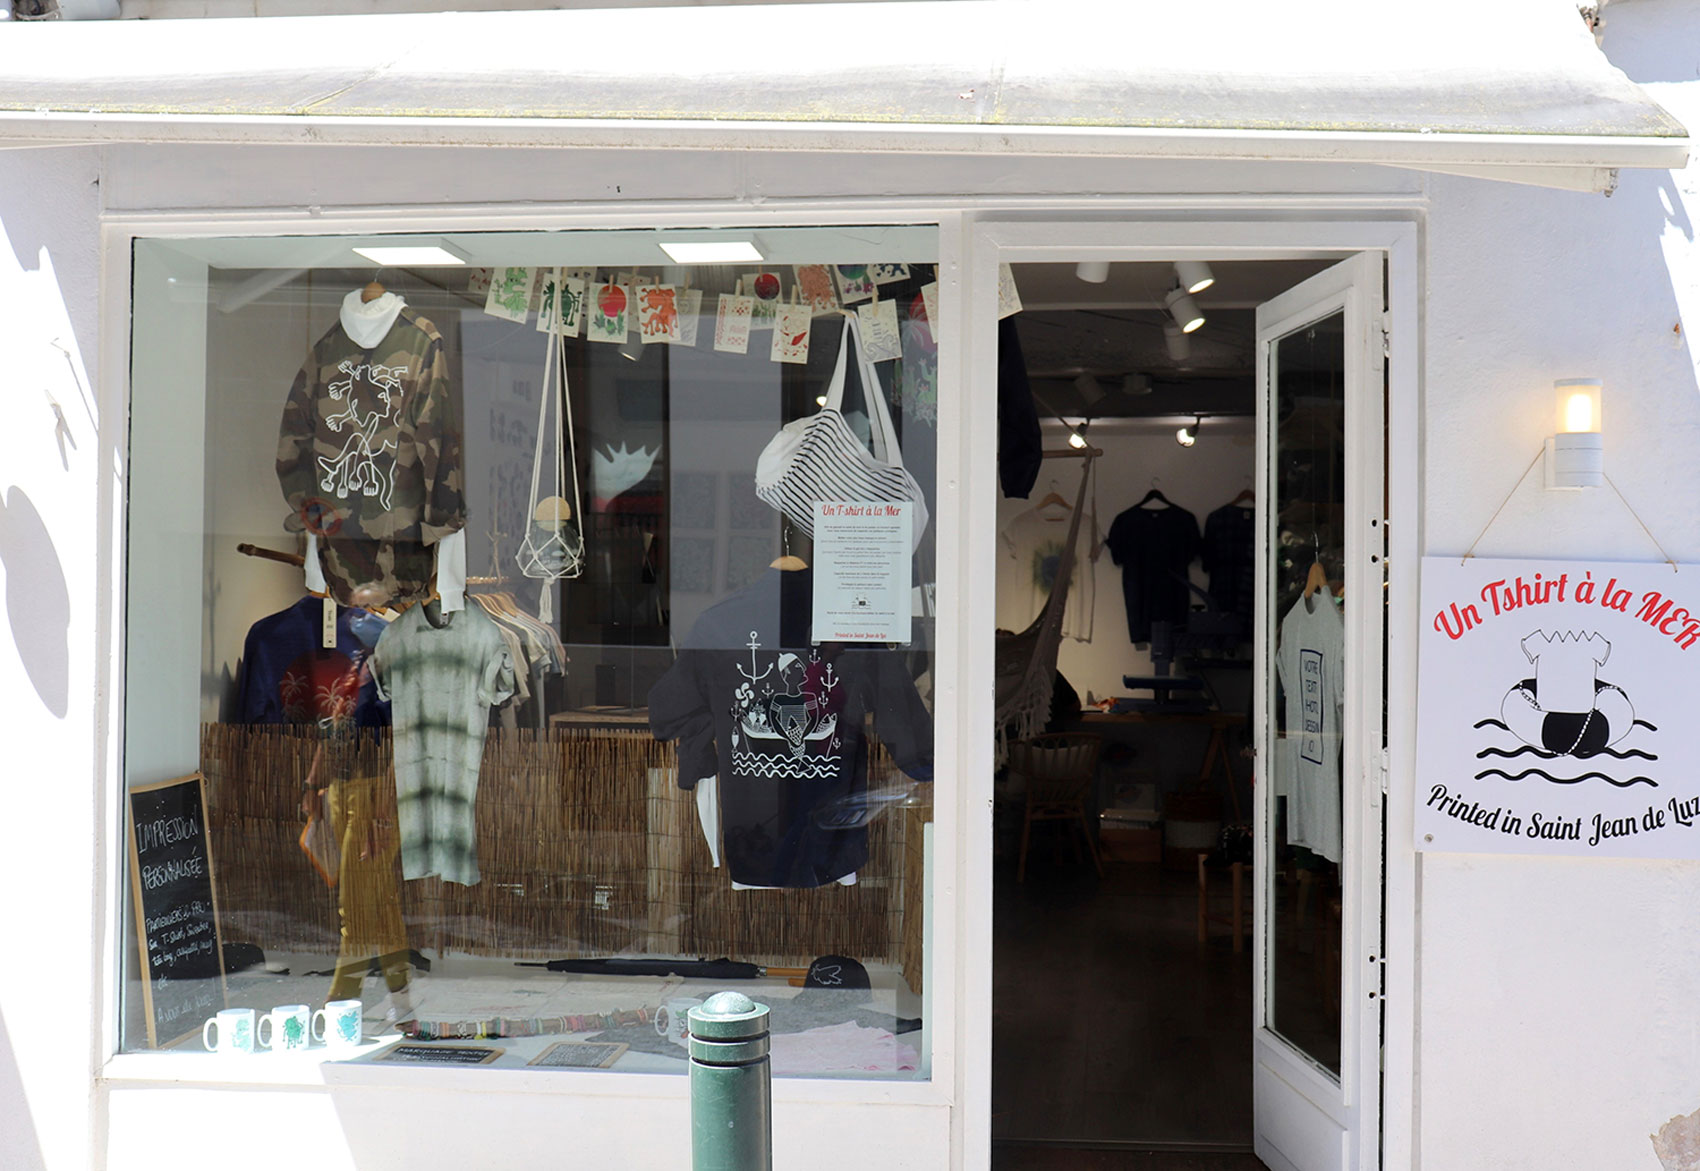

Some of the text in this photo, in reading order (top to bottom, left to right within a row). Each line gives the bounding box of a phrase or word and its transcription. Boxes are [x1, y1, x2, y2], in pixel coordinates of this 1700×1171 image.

[821, 504, 901, 517] Un T-shirt à la Mer
[1434, 571, 1700, 650] Un Tshirt à la MER
[136, 811, 199, 854] IMPRESSION
[1426, 784, 1700, 847] Printed in Saint Jean de Luz
